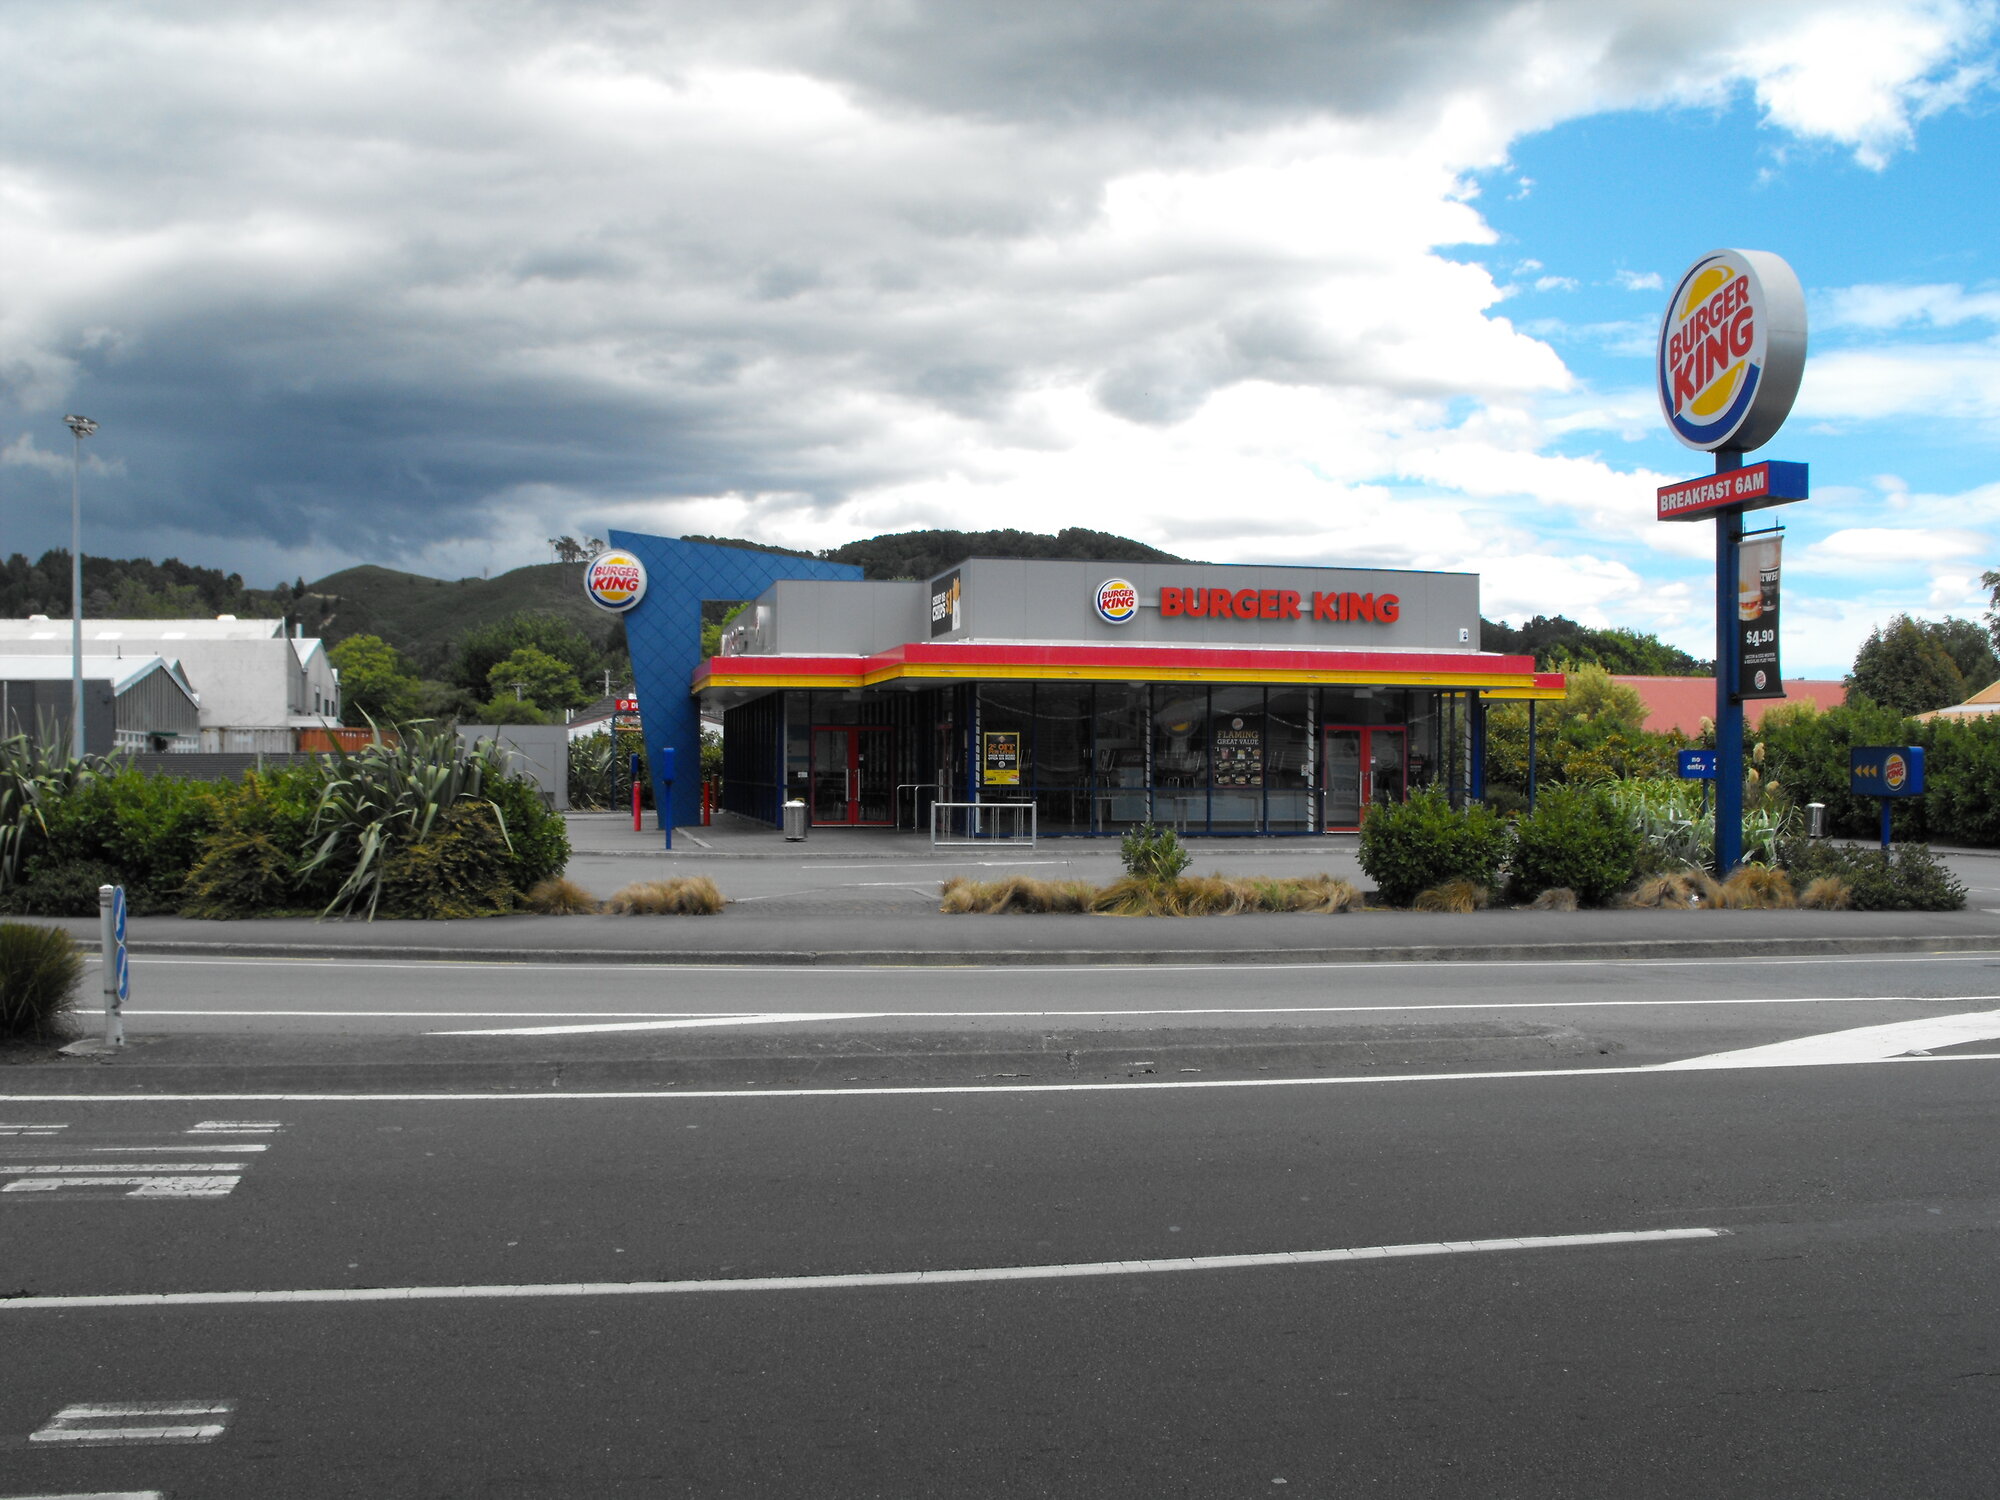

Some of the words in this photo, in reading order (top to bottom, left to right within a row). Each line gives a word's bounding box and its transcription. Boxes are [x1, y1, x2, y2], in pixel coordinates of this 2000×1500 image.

[1669, 274, 1749, 373] BURGER
[1674, 305, 1754, 415] KING
[1660, 480, 1732, 512] BREAKFAST
[1735, 471, 1764, 494] 6AM
[593, 566, 639, 577] BURGER
[592, 576, 640, 592] KING
[1102, 589, 1134, 600] BURGER
[1102, 597, 1135, 610] KING
[1160, 587, 1302, 619] BURGER
[1313, 591, 1400, 624] KING
[1746, 629, 1774, 647] $4.90
[1217, 730, 1259, 739] FLAMING
[1687, 763, 1706, 771] entry
[1887, 768, 1904, 779] KING
